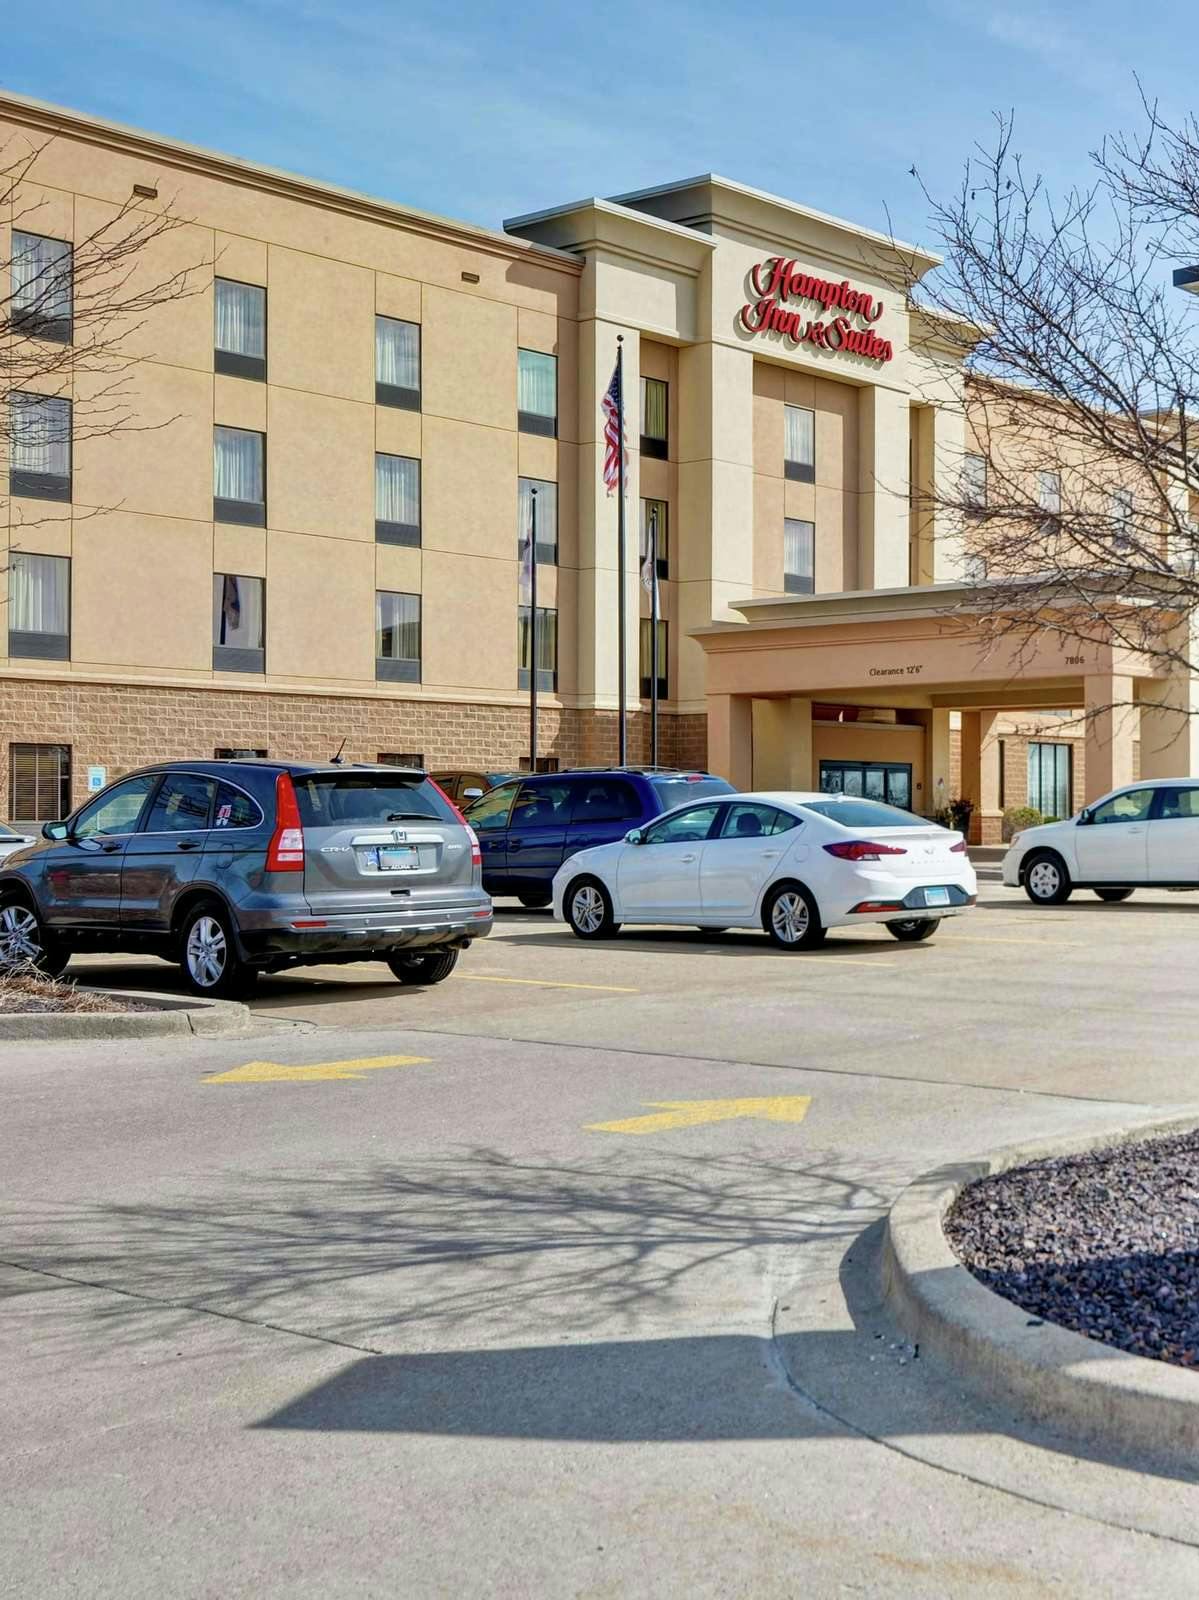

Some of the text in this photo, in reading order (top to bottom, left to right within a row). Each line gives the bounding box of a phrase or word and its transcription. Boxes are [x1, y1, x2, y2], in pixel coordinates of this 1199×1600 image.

[752, 257, 884, 323] Hampton
[741, 299, 893, 362] Inn & Suites
[869, 668, 904, 677] Clearance
